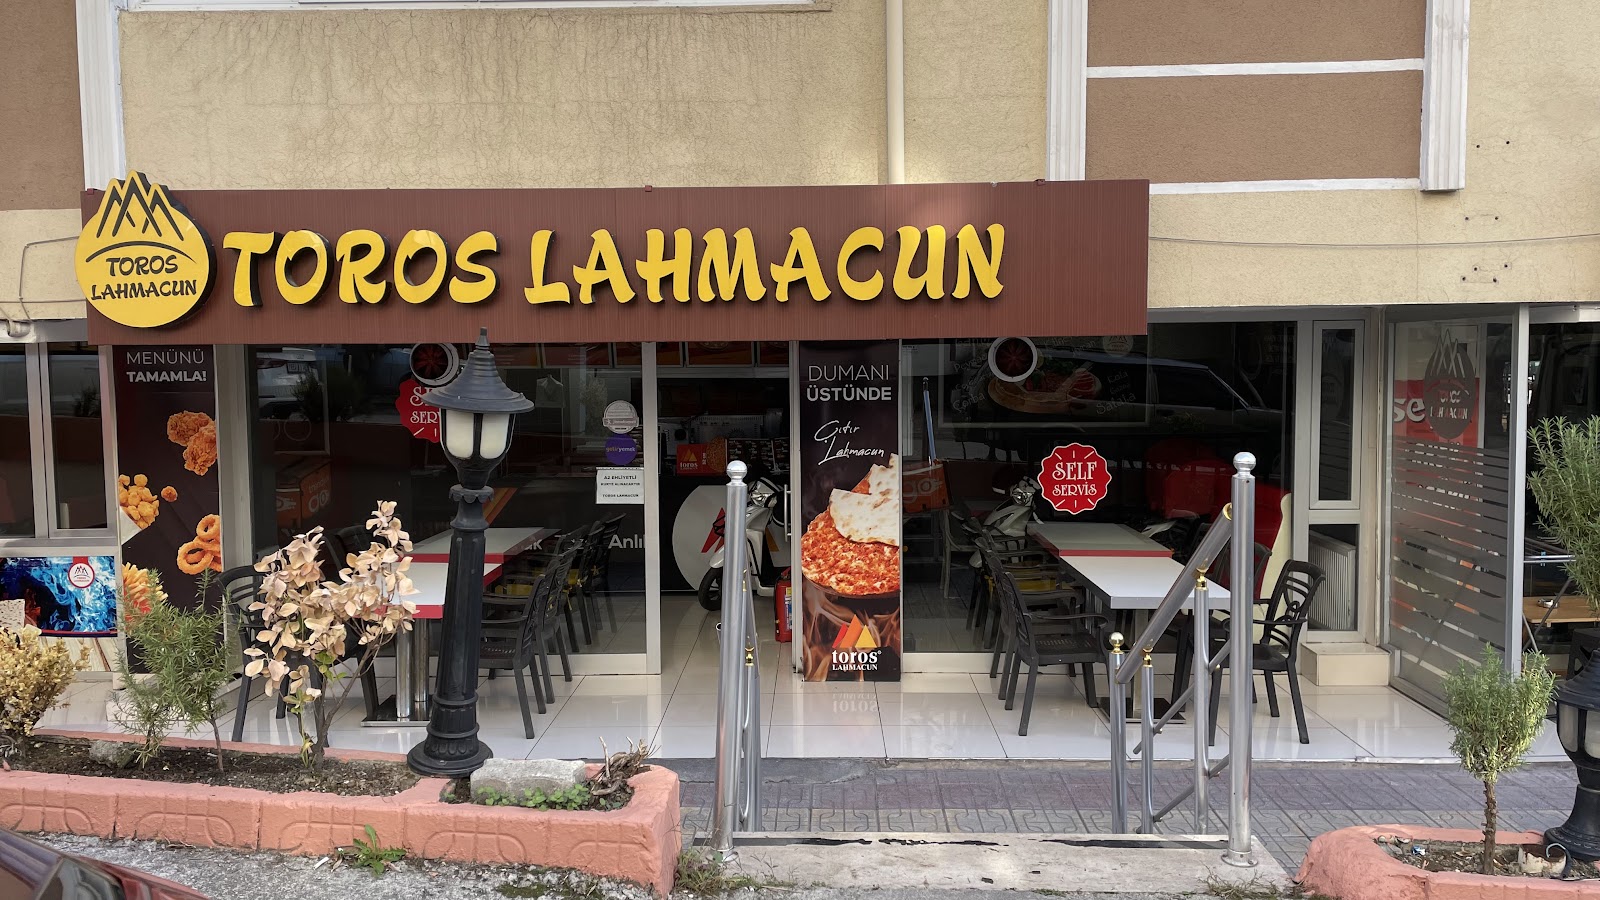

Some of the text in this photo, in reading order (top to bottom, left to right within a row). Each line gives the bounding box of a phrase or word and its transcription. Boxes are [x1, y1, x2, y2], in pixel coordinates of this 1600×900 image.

[105, 254, 178, 276] TOROS
[222, 224, 1005, 306] TOROS LAHMACUN
[91, 280, 197, 300] LAHMACUN
[126, 348, 204, 365] MENÜNÜ
[126, 371, 207, 383] TAMAMLA!
[808, 365, 889, 382] DUMANI
[806, 384, 892, 402] ÜSTÜNDE
[818, 436, 885, 466] Lahmacun
[1052, 461, 1097, 480] SELF
[1052, 481, 1097, 496] SERVİS
[608, 534, 645, 549] Anlı
